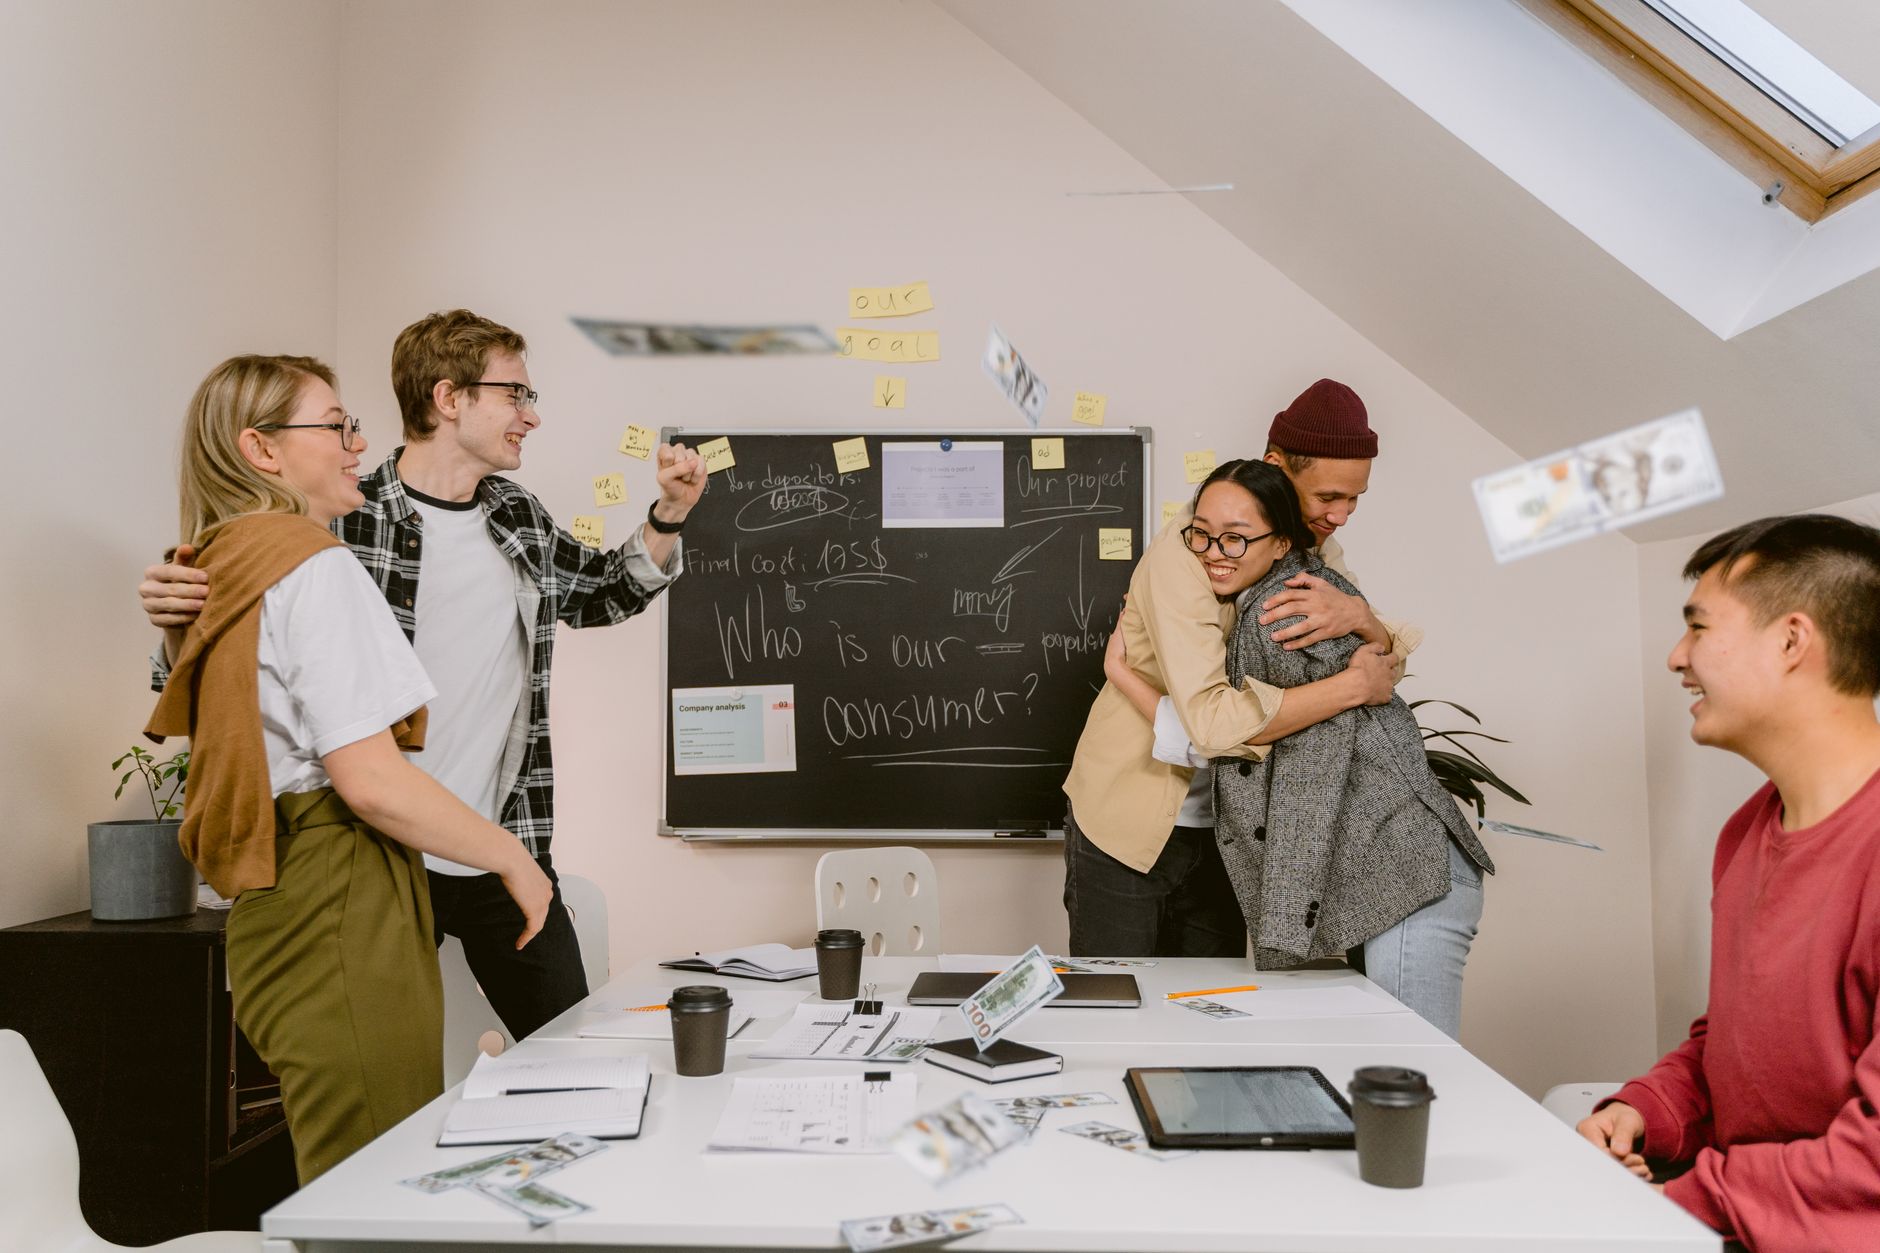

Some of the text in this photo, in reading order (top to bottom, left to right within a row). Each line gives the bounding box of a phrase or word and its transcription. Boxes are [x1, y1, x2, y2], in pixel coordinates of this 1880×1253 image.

[855, 288, 918, 310] our
[841, 335, 927, 358] goal
[1066, 457, 1129, 511] project
[684, 542, 740, 577] Final
[714, 584, 802, 679] Who
[829, 620, 868, 668] is
[679, 703, 746, 713] Company analysis
[967, 1003, 991, 1038] 100
